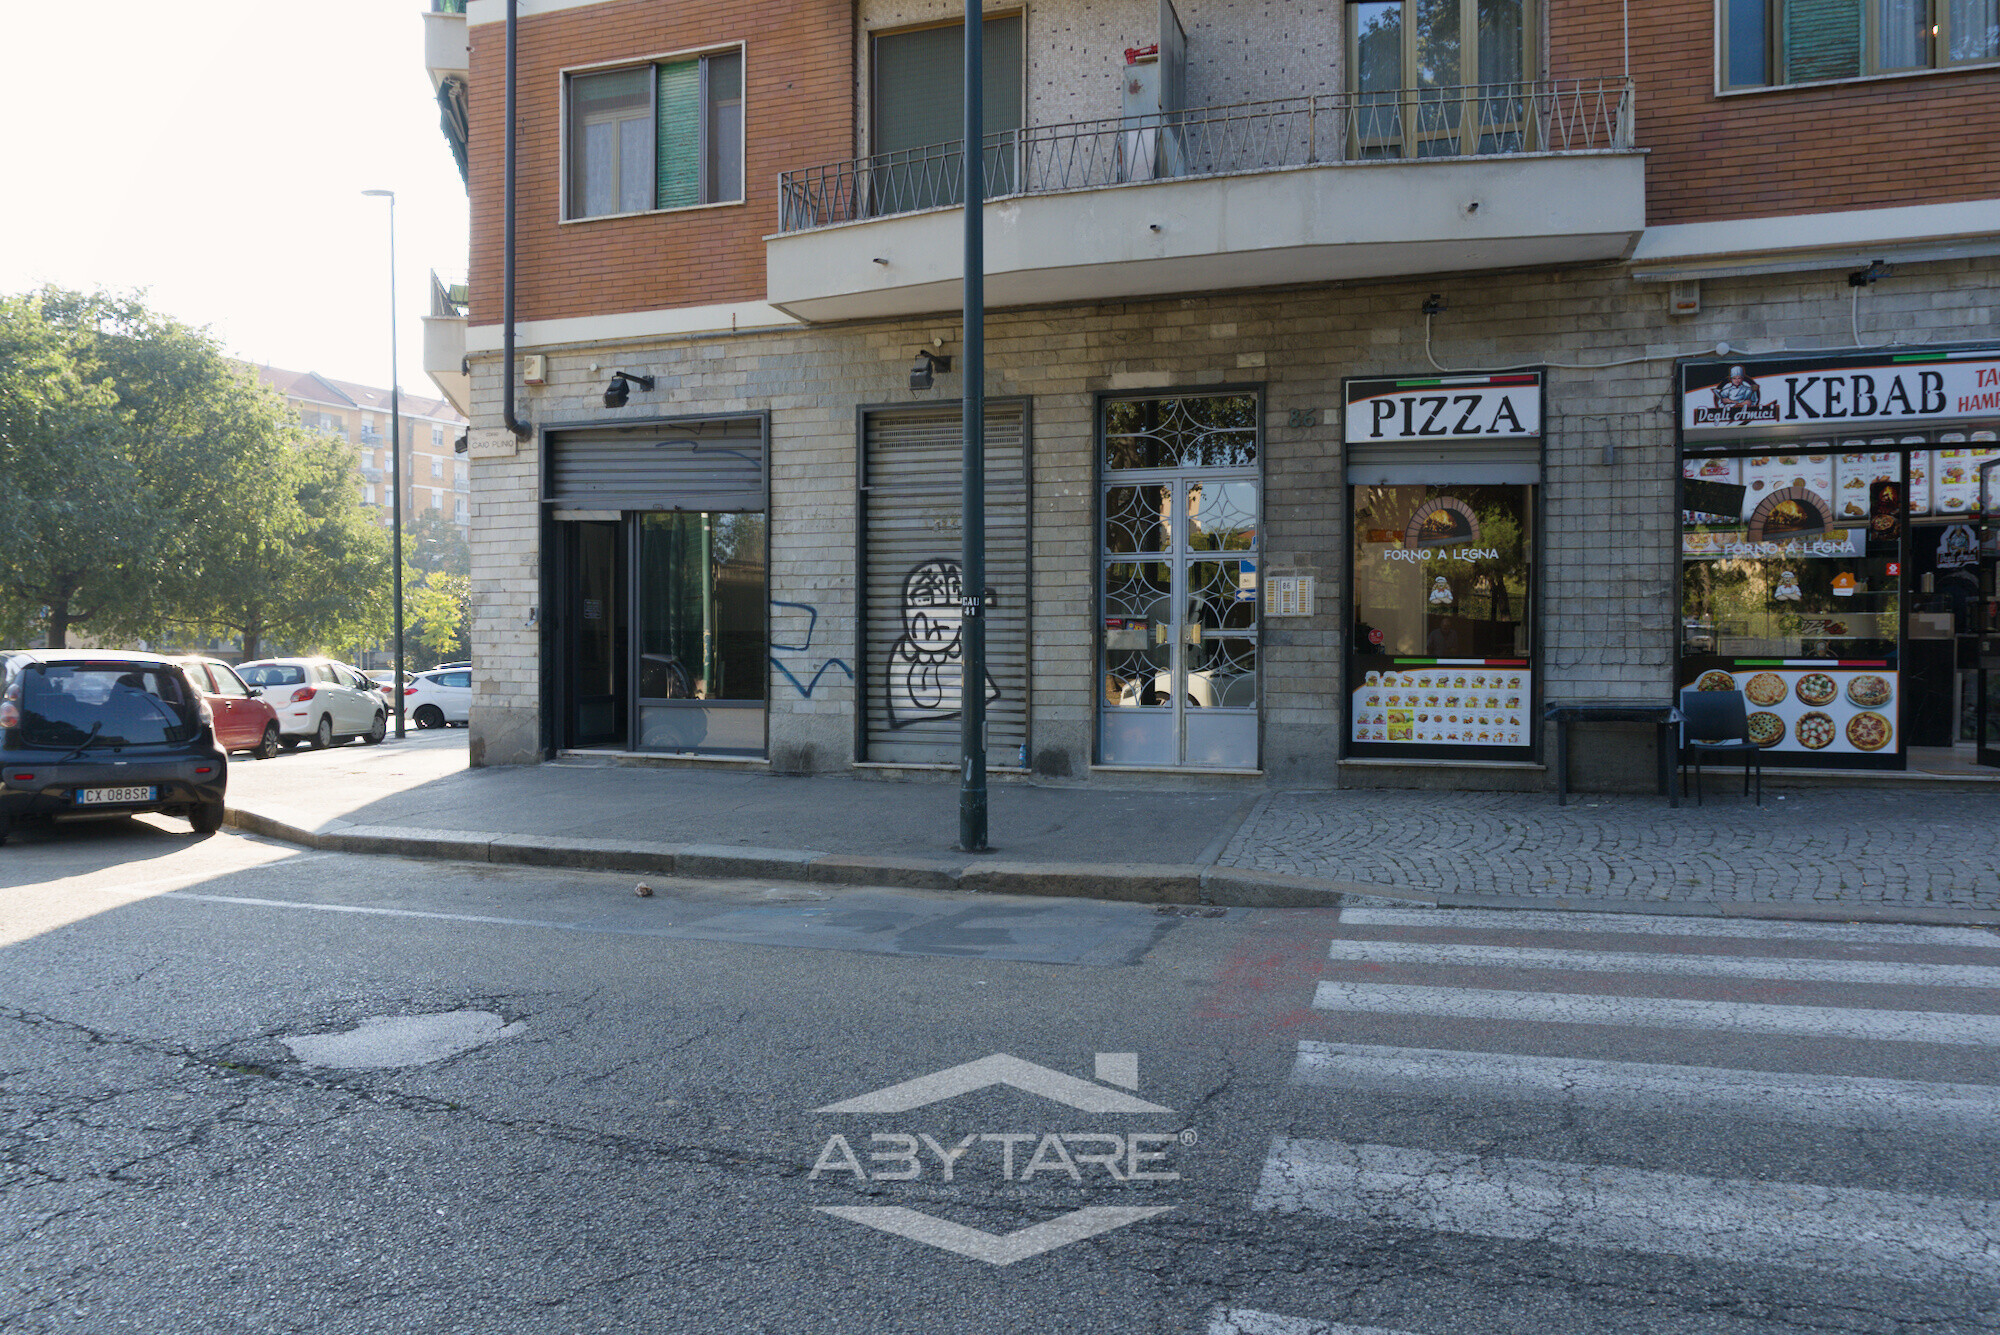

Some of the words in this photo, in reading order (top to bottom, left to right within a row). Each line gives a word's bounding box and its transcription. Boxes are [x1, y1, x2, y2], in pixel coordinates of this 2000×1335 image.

[1975, 368, 2000, 387] TA
[1784, 371, 1947, 420] KEBAB
[1289, 408, 1316, 428] 86
[1369, 395, 1526, 438] PIZZA
[1697, 404, 1731, 426] Degli
[1734, 403, 1774, 421] Amici
[1384, 549, 1431, 564] FORNO
[1437, 549, 1448, 560] A
[1453, 548, 1499, 563] LEGNA
[1724, 542, 1778, 558] FORNO
[1785, 542, 1797, 555] A
[1803, 541, 1855, 557] LEGNA
[1282, 582, 1291, 590] 86
[86, 790, 102, 802] CX
[107, 787, 148, 801] 088SR
